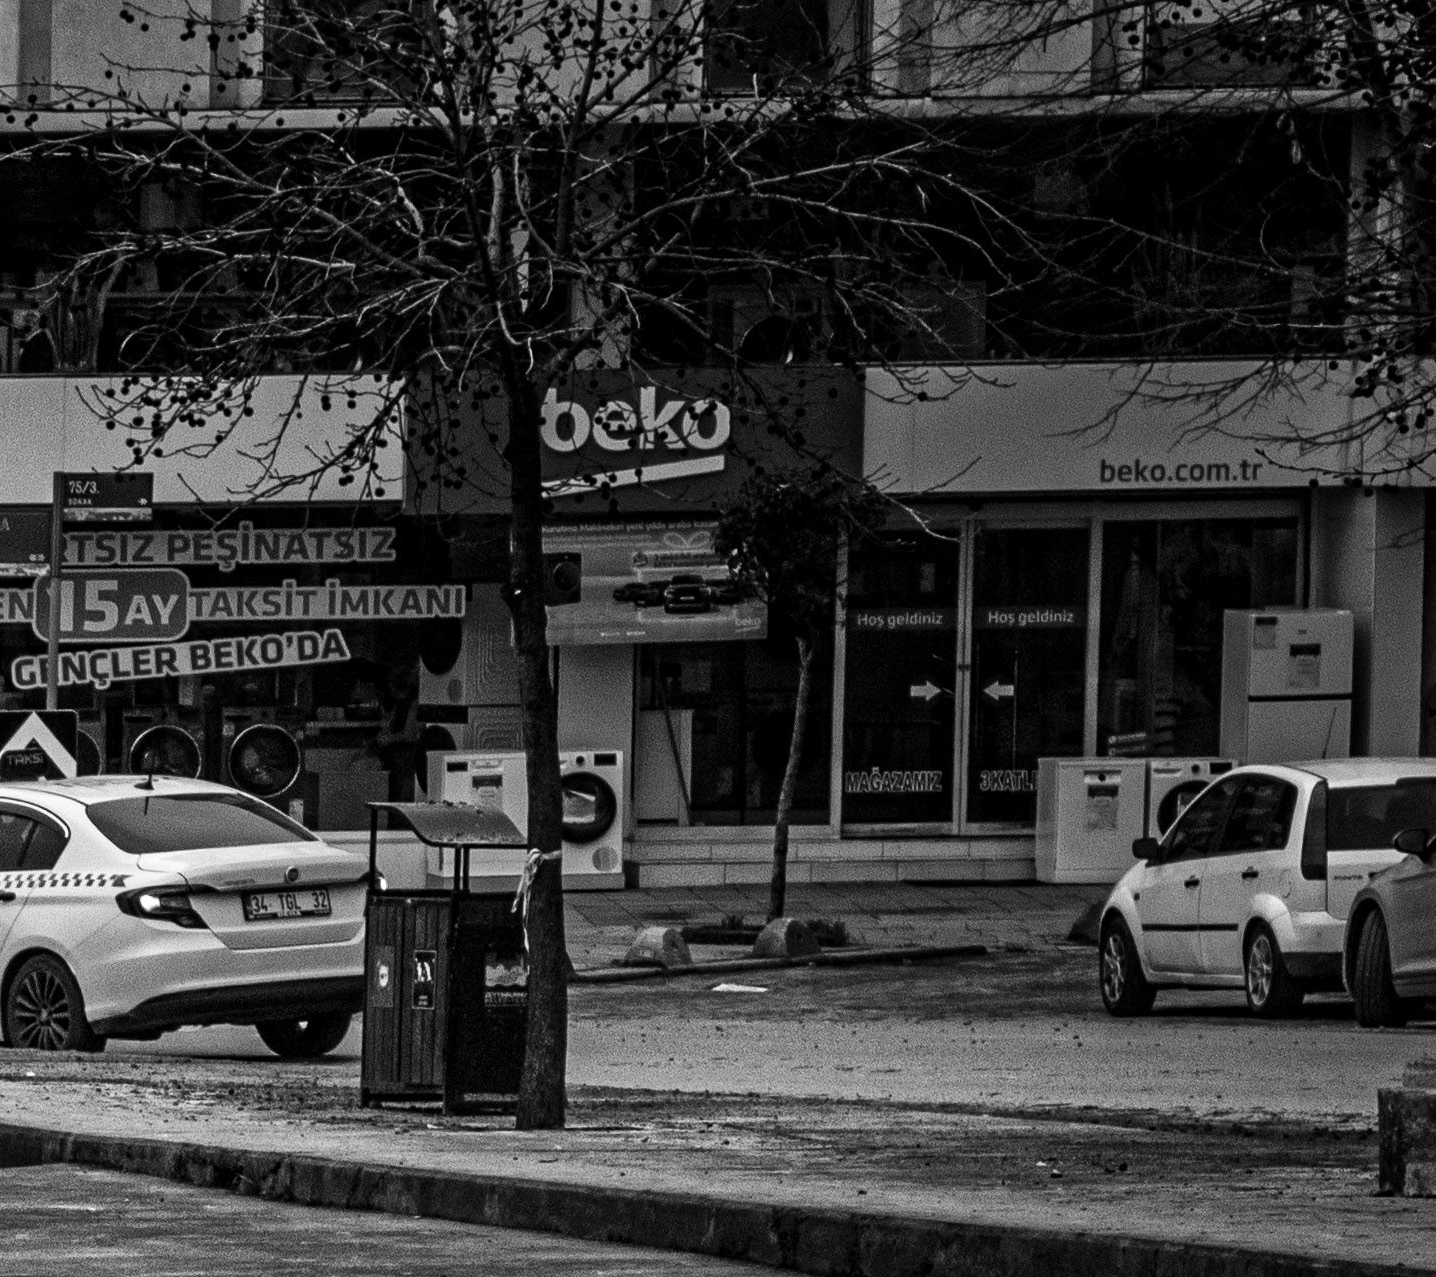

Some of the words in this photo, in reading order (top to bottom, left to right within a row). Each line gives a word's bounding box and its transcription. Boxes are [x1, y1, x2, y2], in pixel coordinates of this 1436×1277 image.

[540, 386, 731, 453] beko
[1100, 458, 1263, 483] beko.com.tr
[68, 481, 100, 494] 75/3.
[167, 523, 394, 569] PEŞİNATSIZ
[46, 579, 121, 633] 15
[124, 593, 180, 626] AY
[189, 579, 318, 618] TAKSİT
[329, 579, 463, 618] İMKANI
[988, 611, 1016, 625] Hoş
[1019, 609, 1075, 626] geldiniz
[857, 613, 885, 627] Hoş
[887, 612, 944, 630] geldiniz
[846, 766, 944, 793] MAĞAZAMIZ
[252, 896, 268, 912] 34
[278, 894, 302, 910] TGL
[312, 892, 328, 908] 32
